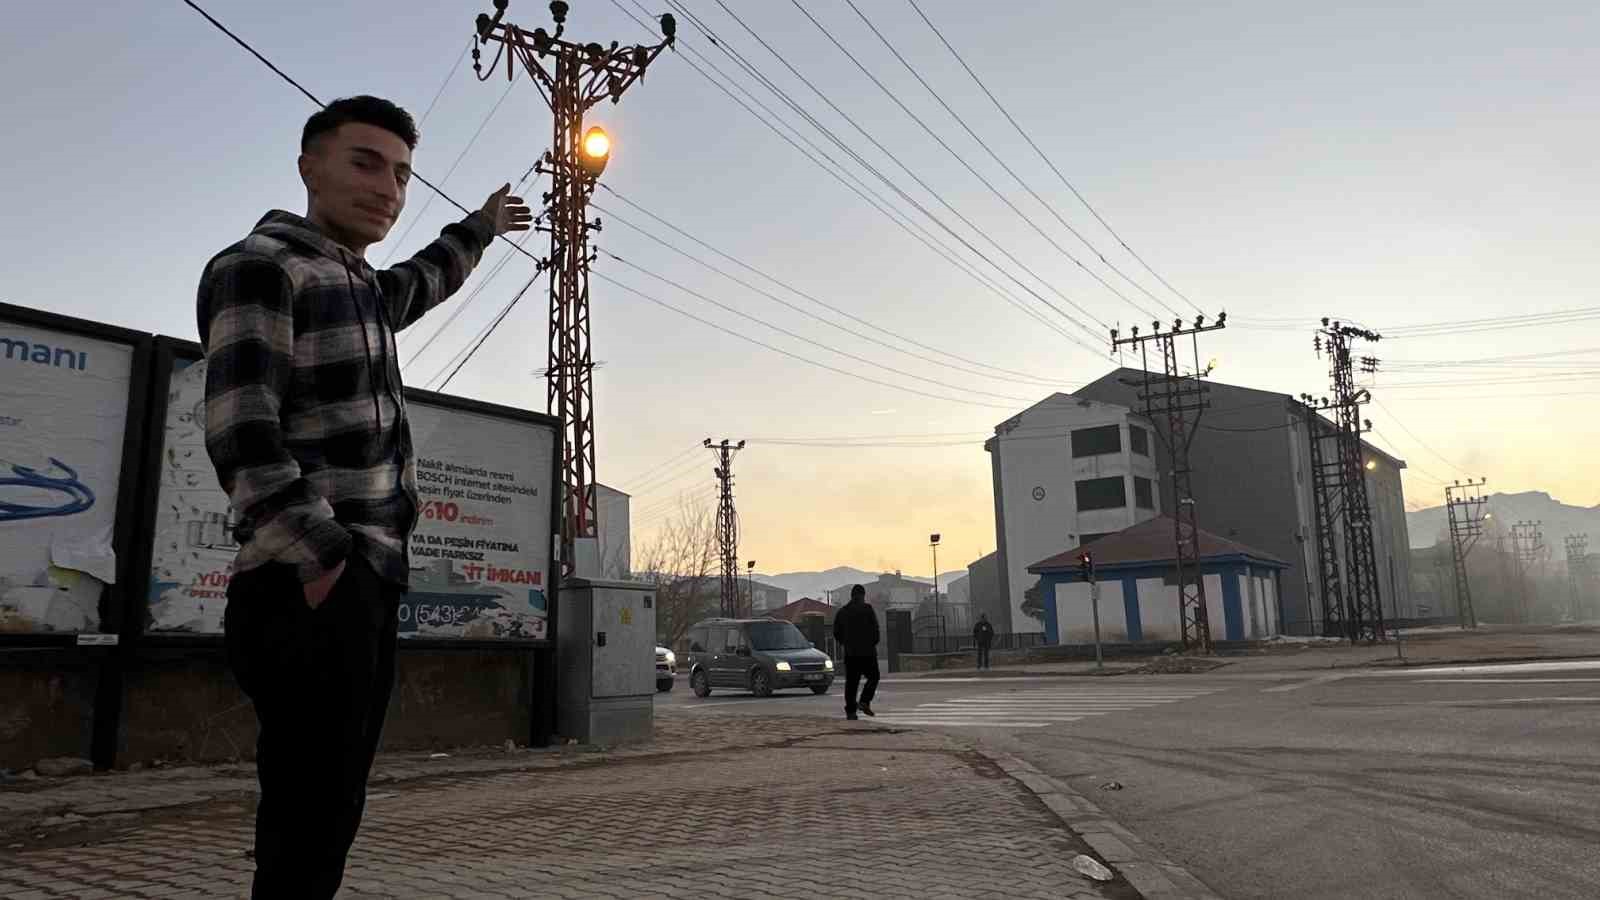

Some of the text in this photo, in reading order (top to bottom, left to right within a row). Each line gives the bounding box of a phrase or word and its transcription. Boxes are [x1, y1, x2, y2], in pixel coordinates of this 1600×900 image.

[417, 458, 514, 482] Nakit alımlarda resmi
[417, 470, 538, 496] BOSCH internet sitesindeki
[443, 487, 464, 499] fiyat
[466, 490, 512, 504] üzerinden
[416, 499, 458, 522] %10
[411, 546, 485, 561] VADE FARKSIZ
[412, 534, 519, 552] YA DA PEŞİN FİYATINA
[487, 563, 541, 585] İMKANI
[415, 600, 455, 625] (543)
